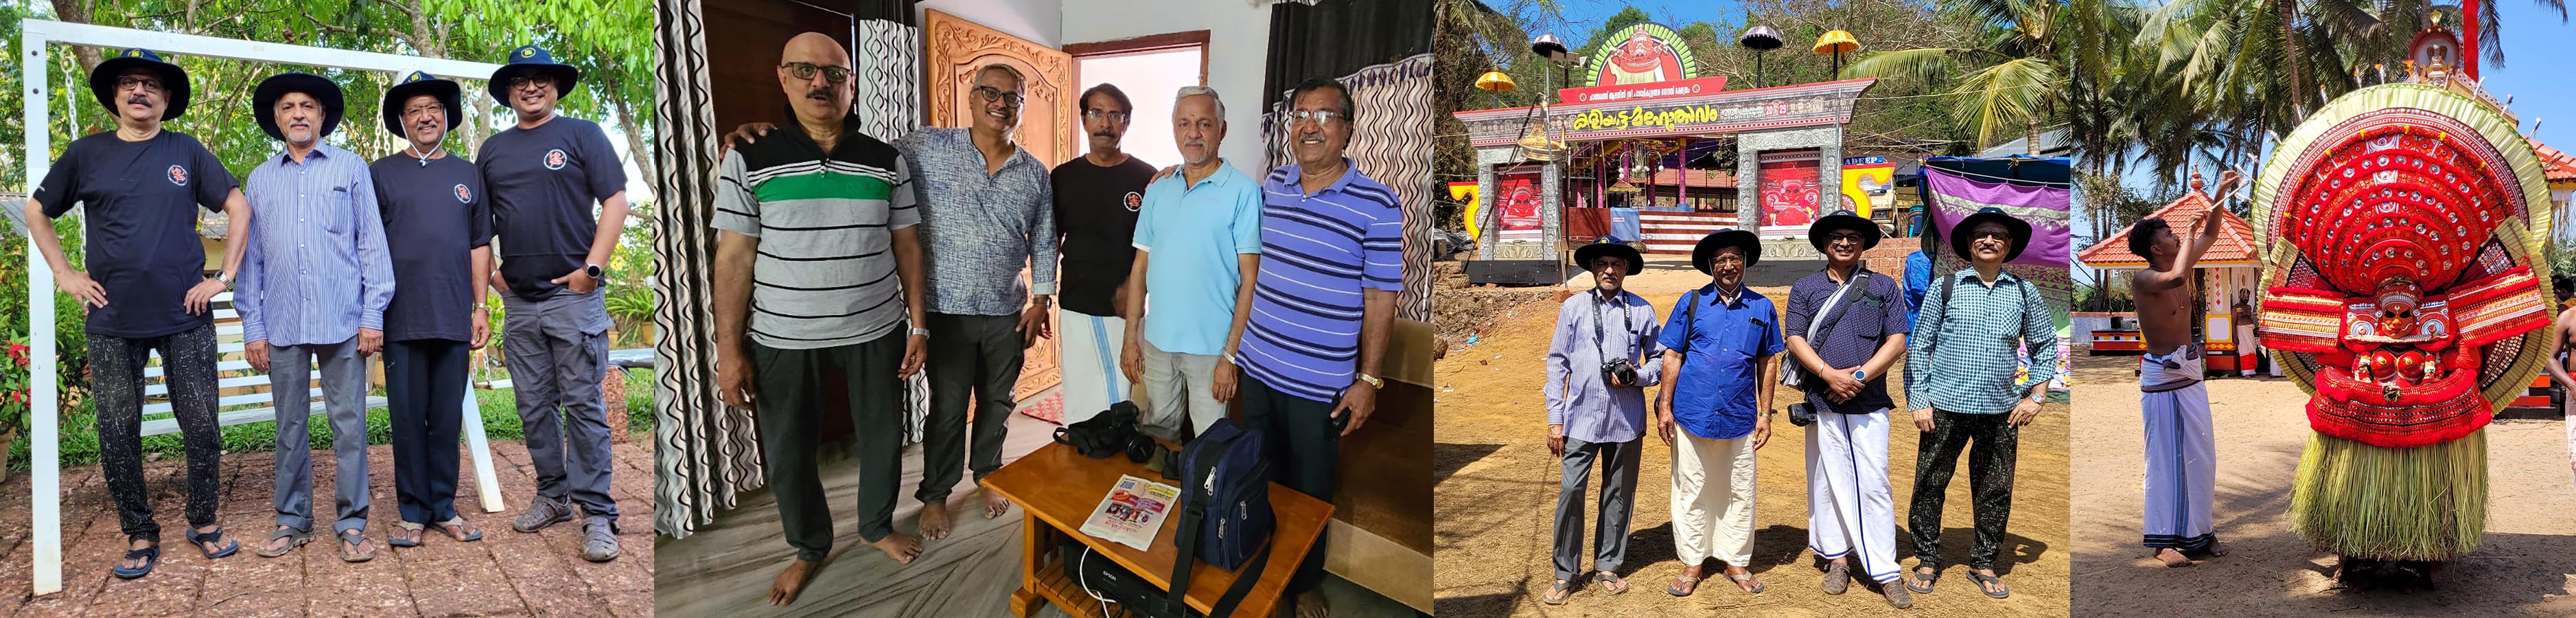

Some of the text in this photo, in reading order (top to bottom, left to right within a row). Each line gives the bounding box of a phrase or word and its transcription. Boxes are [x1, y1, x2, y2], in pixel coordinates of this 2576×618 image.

[1766, 106, 1773, 115] 20
[1779, 104, 1787, 114] 25
[1103, 571, 1116, 581] EPSON
